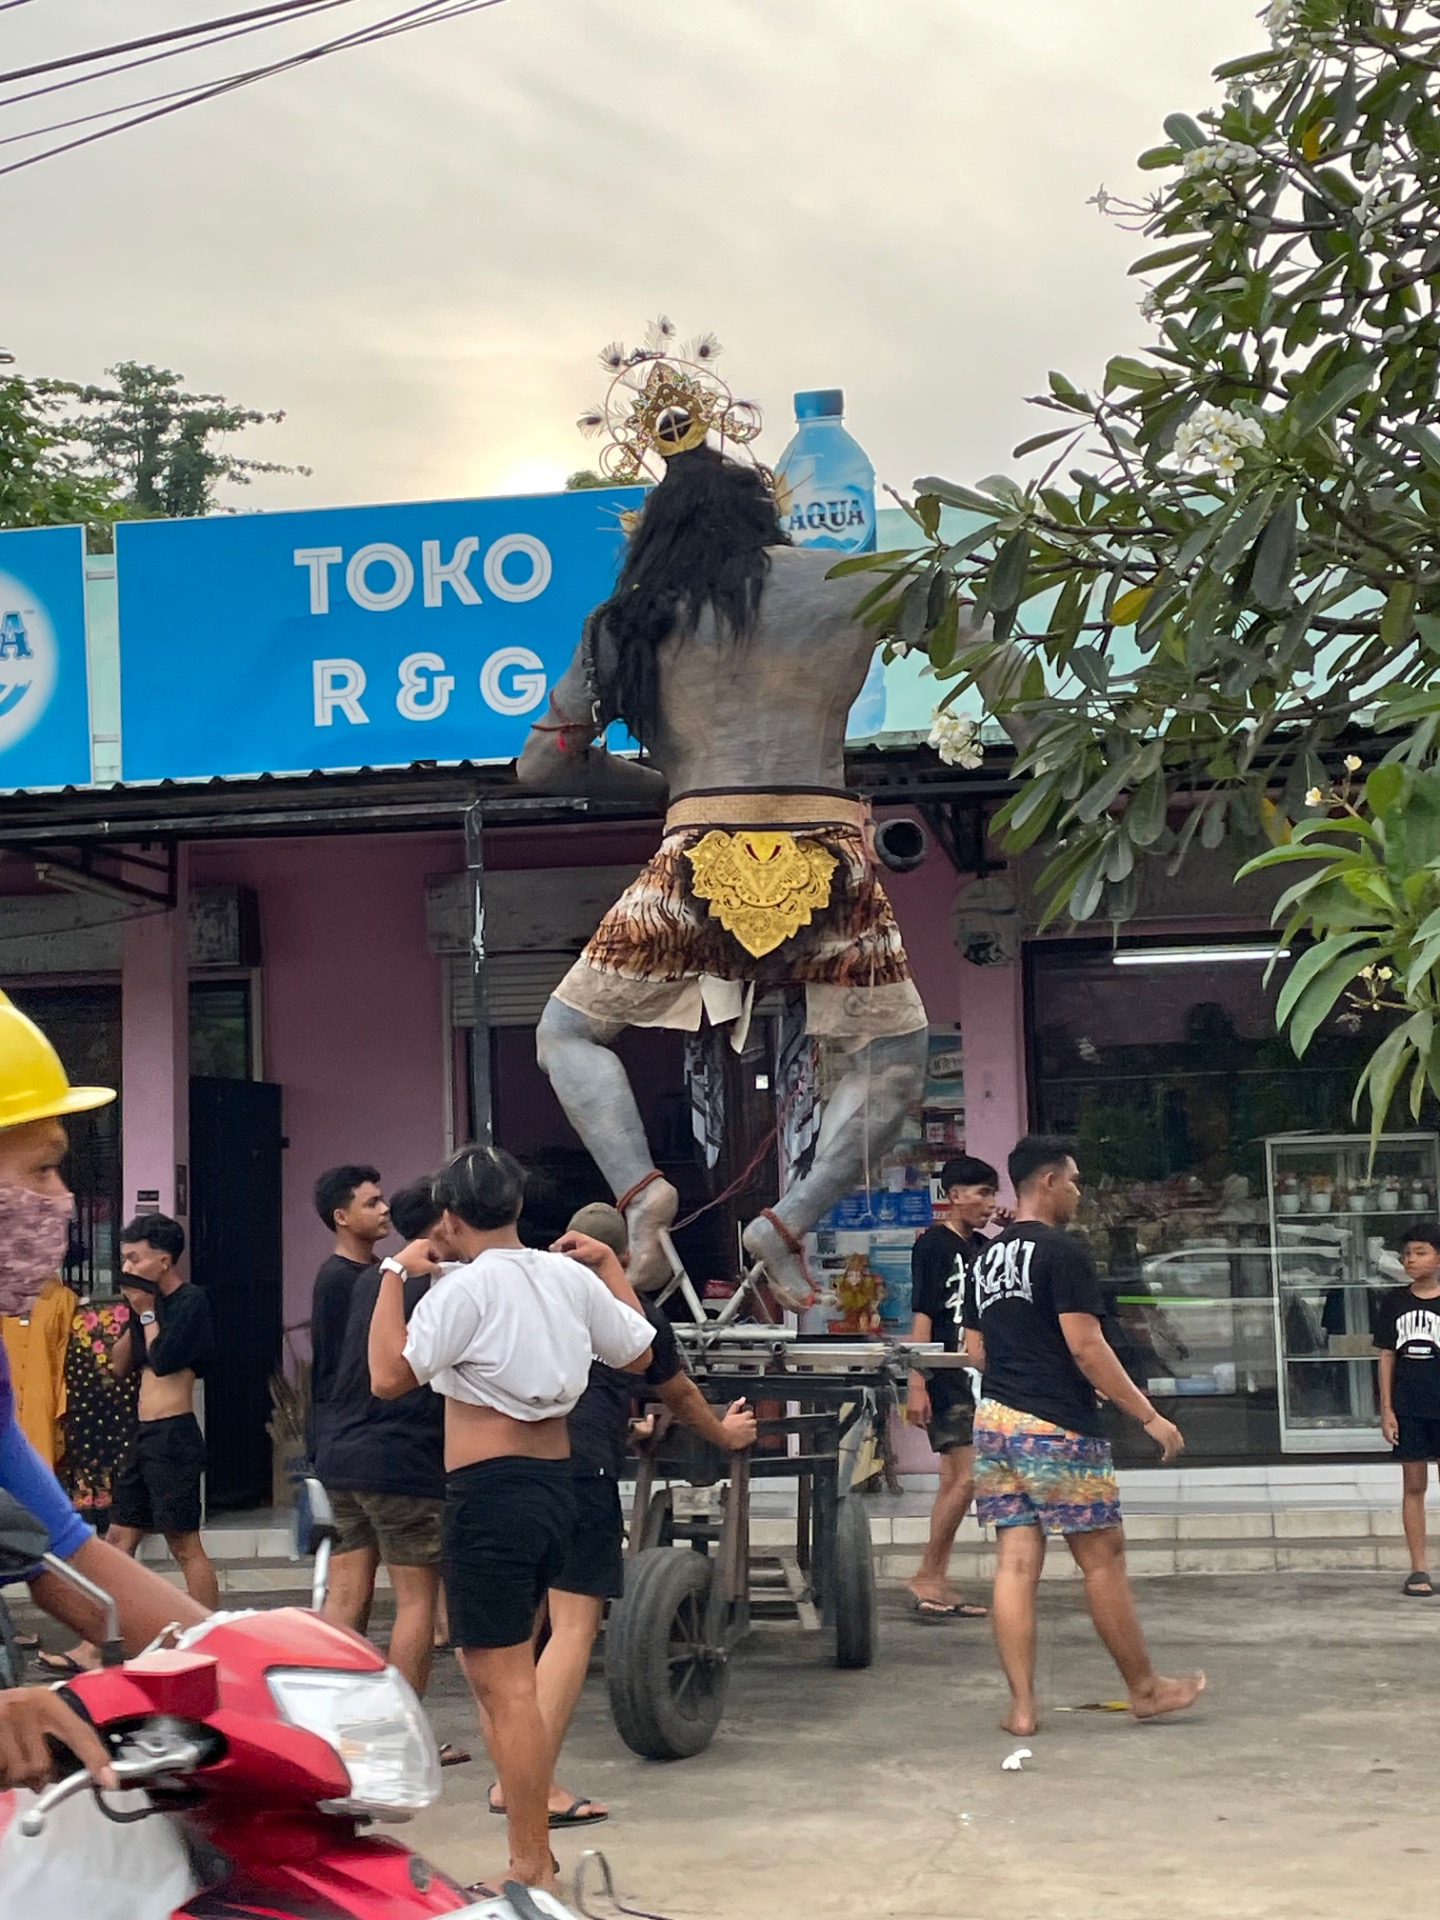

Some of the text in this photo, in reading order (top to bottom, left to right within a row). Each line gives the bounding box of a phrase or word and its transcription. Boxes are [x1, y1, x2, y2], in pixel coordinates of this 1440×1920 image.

[788, 500, 866, 534] AQUA
[293, 533, 553, 615] TOKO
[312, 646, 547, 727] R & G
